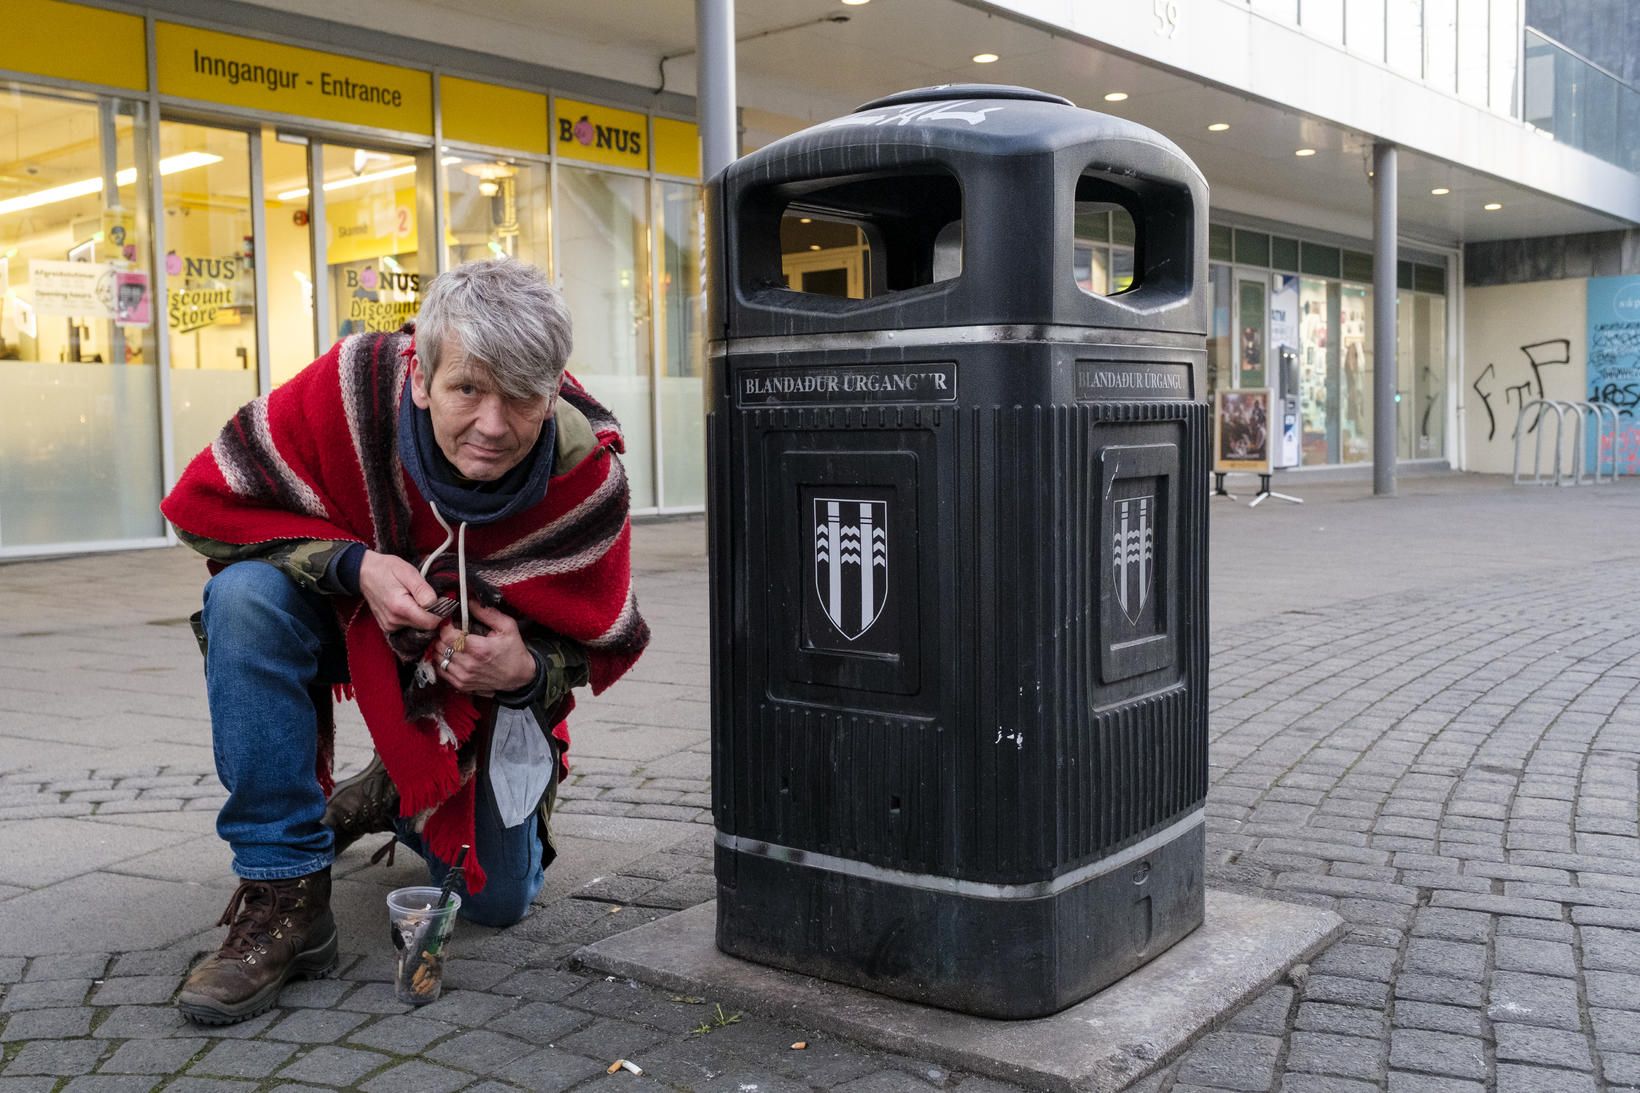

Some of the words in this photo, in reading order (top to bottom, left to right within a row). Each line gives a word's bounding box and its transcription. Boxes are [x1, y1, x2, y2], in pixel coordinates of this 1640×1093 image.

[194, 48, 299, 91] Inngangur
[320, 72, 402, 107] Entrance
[169, 307, 216, 328] Store
[351, 299, 419, 318] Discount
[1145, 368, 1185, 390] ÚRGANGU
